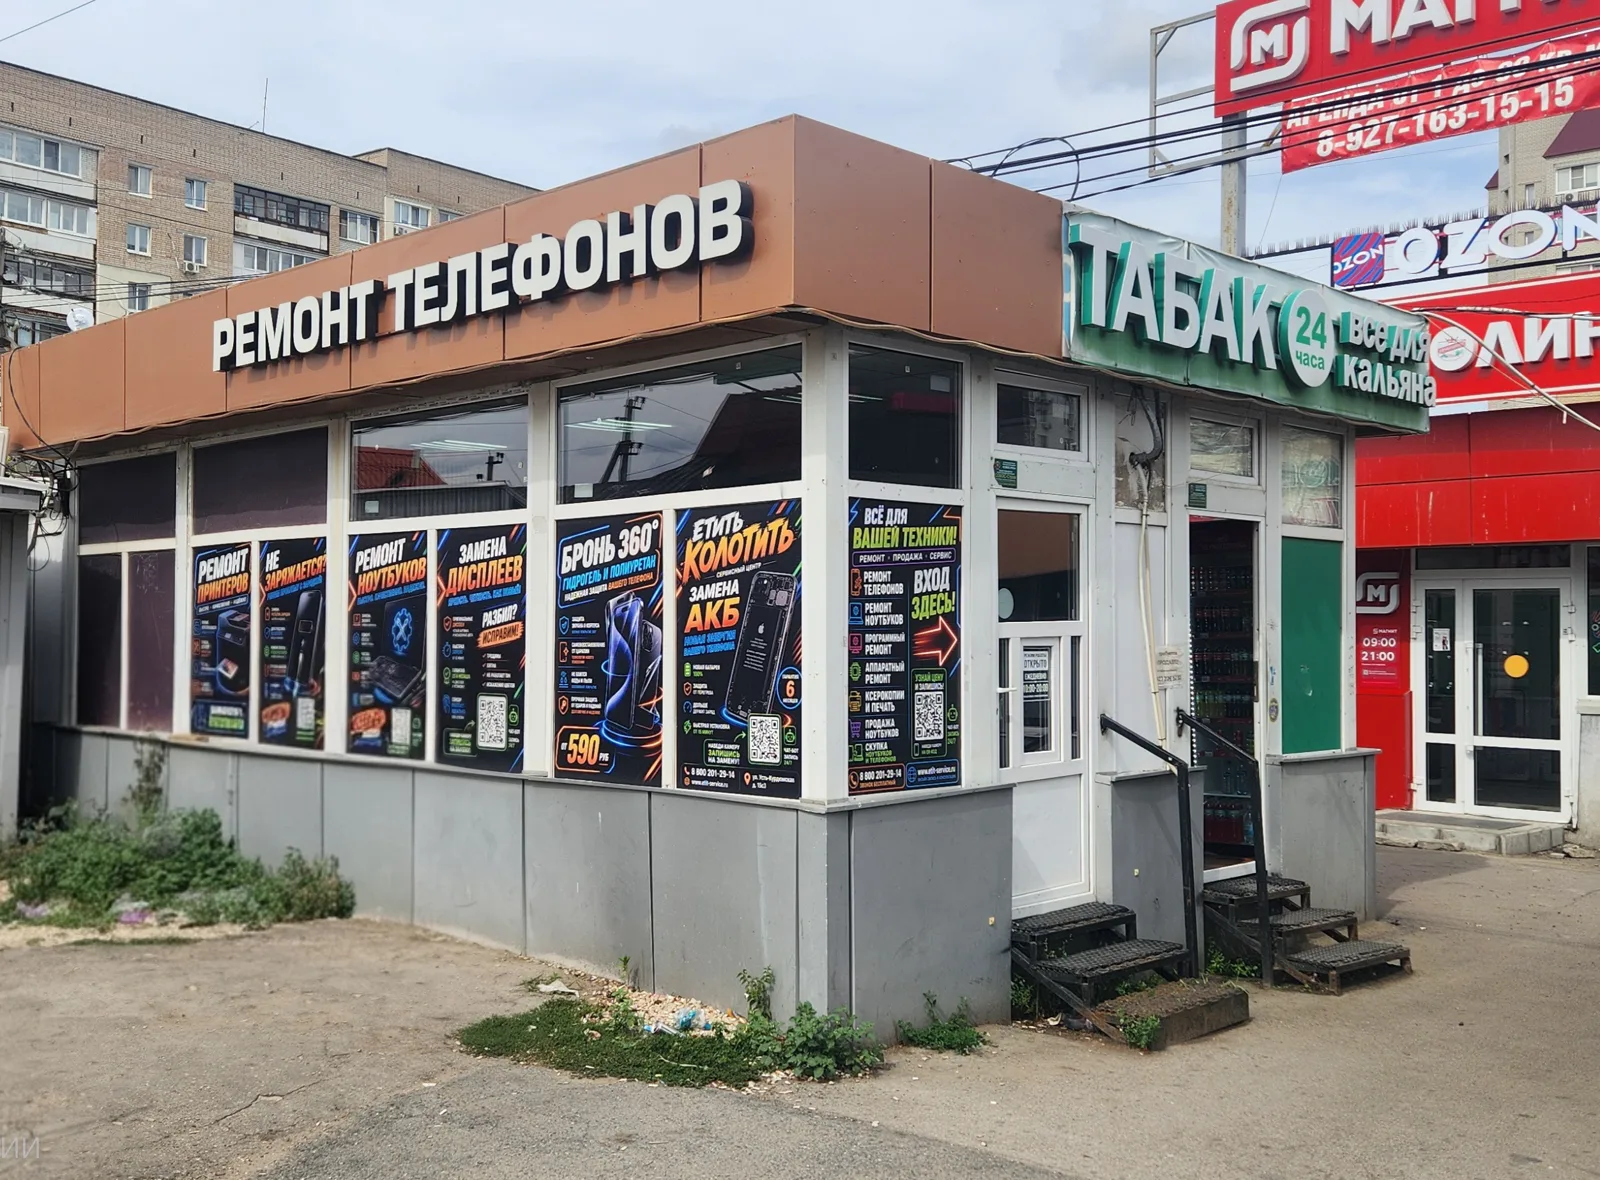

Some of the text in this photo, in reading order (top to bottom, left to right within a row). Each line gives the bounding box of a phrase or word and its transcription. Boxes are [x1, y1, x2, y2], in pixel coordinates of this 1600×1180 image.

[1316, 76, 1574, 157] 8-927-163-15-15
[213, 179, 744, 372] РЕМОНТ ТЕЛЕФОНОВ
[1069, 223, 1277, 370] ТАБАК
[1296, 306, 1327, 350] 24
[1295, 350, 1325, 370] часа
[692, 510, 744, 542] ЕТИТЬ
[864, 505, 908, 526] ВСЁ ДЛЯ
[561, 519, 659, 574] БРОНЬ 360°
[853, 526, 957, 549] ВАШЕЙ ТЕХНИКИ!
[265, 549, 280, 572] НЕ
[355, 538, 406, 573] РЕМОНТ
[459, 536, 506, 564] ЗАМЕНА
[681, 516, 797, 584] КОЛОТИТЬ
[859, 551, 952, 563] РЕМОНТ ПРОДАЖА СЕРВИС
[198, 547, 249, 583] РЕМОНТ
[265, 554, 327, 592] ЗАРЯЖАЕТСЯ?
[357, 557, 426, 595] НОУТБУКОВ
[445, 555, 523, 597] ДИСПЛЕЕВ
[562, 555, 656, 591] ГИДРОГЕЛЬ И ПОЛИУРЕТАН
[197, 572, 249, 604] ПРИНТЕРОВ
[864, 571, 892, 583] РЕМОНТ
[913, 566, 950, 594] ВХОД
[689, 579, 739, 602] ЗАМЕНА
[864, 583, 904, 596] ТЕЛЕФОНОВ
[482, 603, 518, 628] РАЗБИЛ?
[684, 596, 740, 633] АКБ
[865, 602, 893, 614] РЕМОНТ
[911, 591, 956, 620] ЗДЕСЬ!
[865, 614, 904, 626] НОУТБУКОВ
[482, 623, 520, 645] ИСПРАВИМ!
[865, 632, 906, 643] ПРОГРАММНЫЙ
[1363, 637, 1396, 647] 09:00
[865, 644, 893, 656] РЕМОНТ
[1361, 651, 1395, 661] 21:00
[865, 661, 905, 673] АППАРАТНЫЙ
[865, 673, 892, 684] РЕМОНТ
[786, 680, 795, 698] 6
[865, 690, 905, 701] КСЕРОКОПИИ
[865, 702, 896, 713] И ПЕЧАТЬ
[865, 718, 895, 730] ПРОДАЖА
[865, 728, 899, 740] НОУТБУКОВ
[567, 733, 600, 766] 590
[598, 753, 609, 762] РУБ
[708, 749, 740, 758] ЗАПИШИСЬ
[865, 742, 888, 751] СКУПКА
[691, 767, 696, 776] 8
[696, 768, 707, 777] 800
